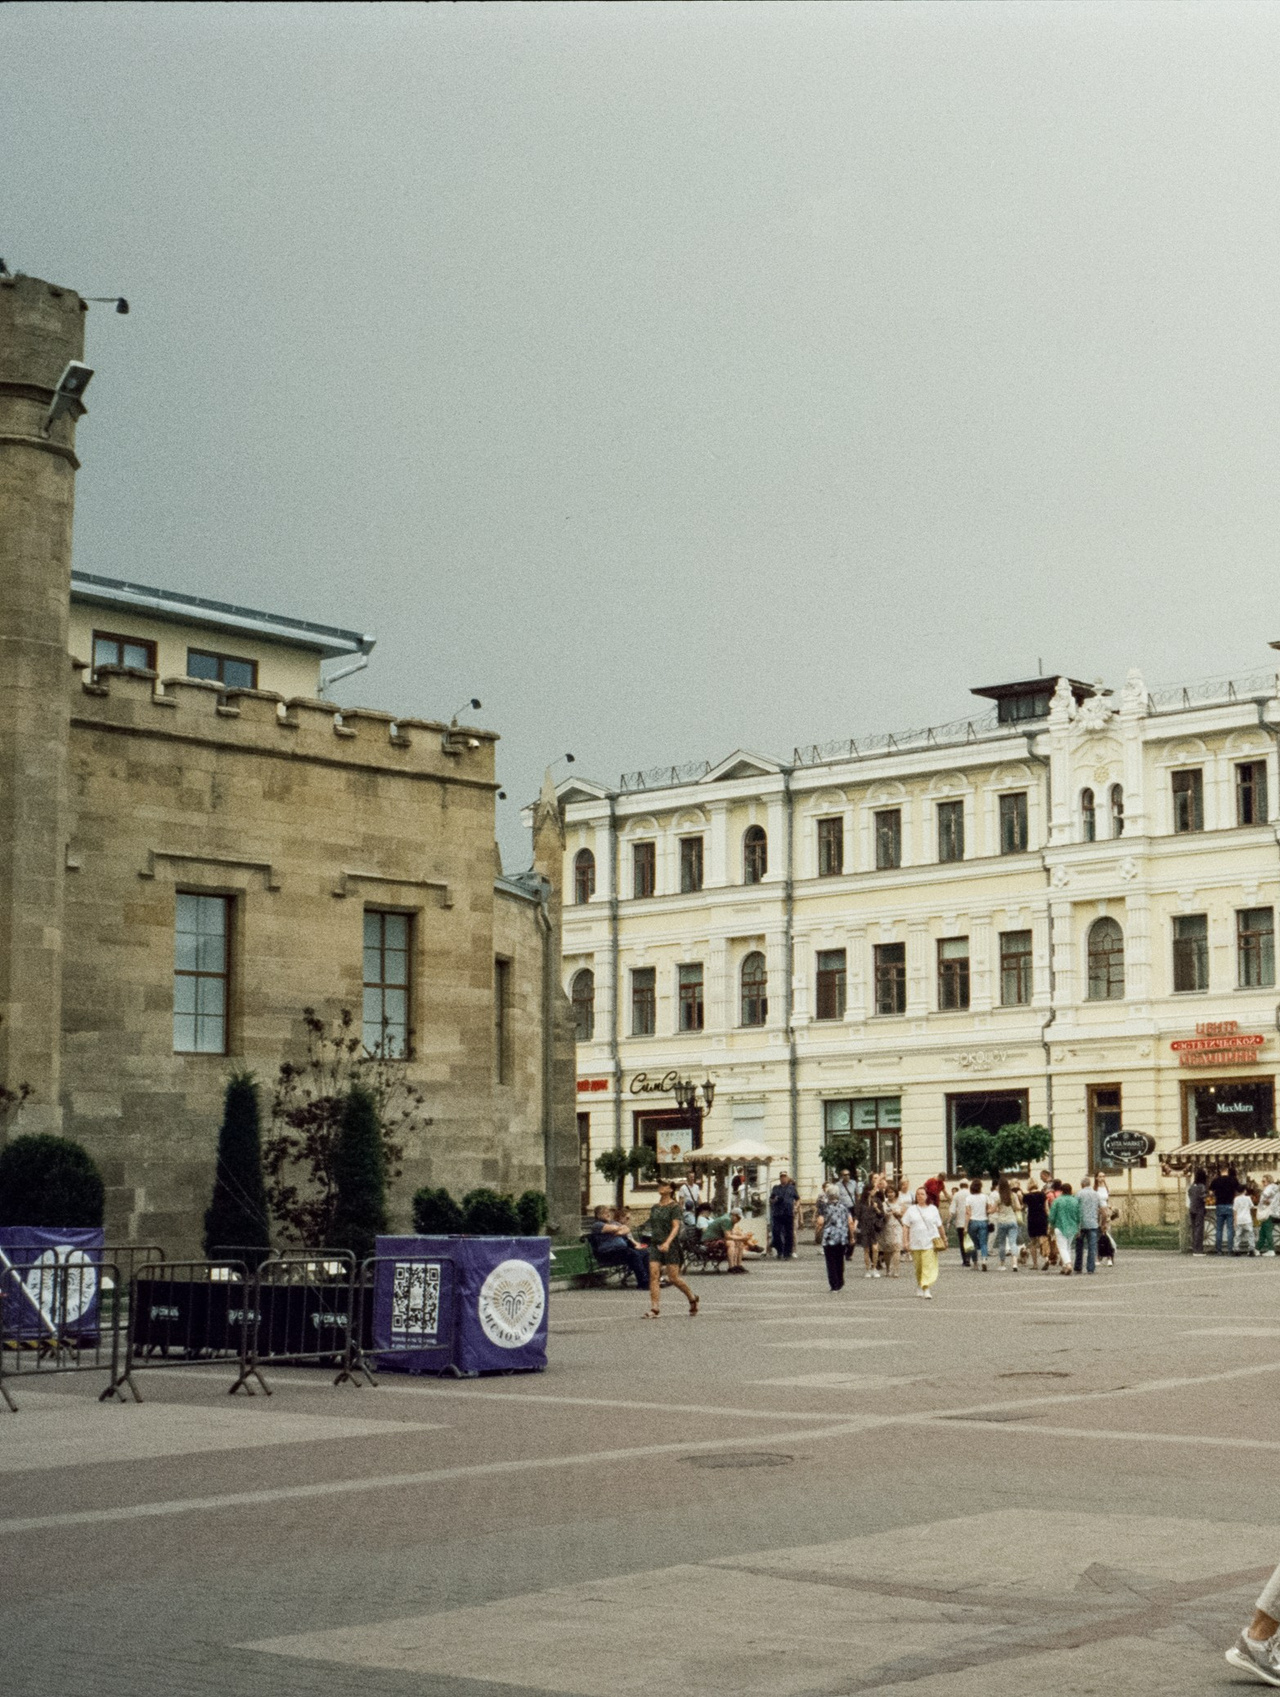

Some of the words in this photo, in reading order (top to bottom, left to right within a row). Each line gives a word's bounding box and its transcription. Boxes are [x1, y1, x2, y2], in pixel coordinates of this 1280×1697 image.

[1195, 1021, 1238, 1034] ЦЕНТР
[953, 1050, 1007, 1065] SOKOLOV
[1216, 1103, 1253, 1113] MaxMara
